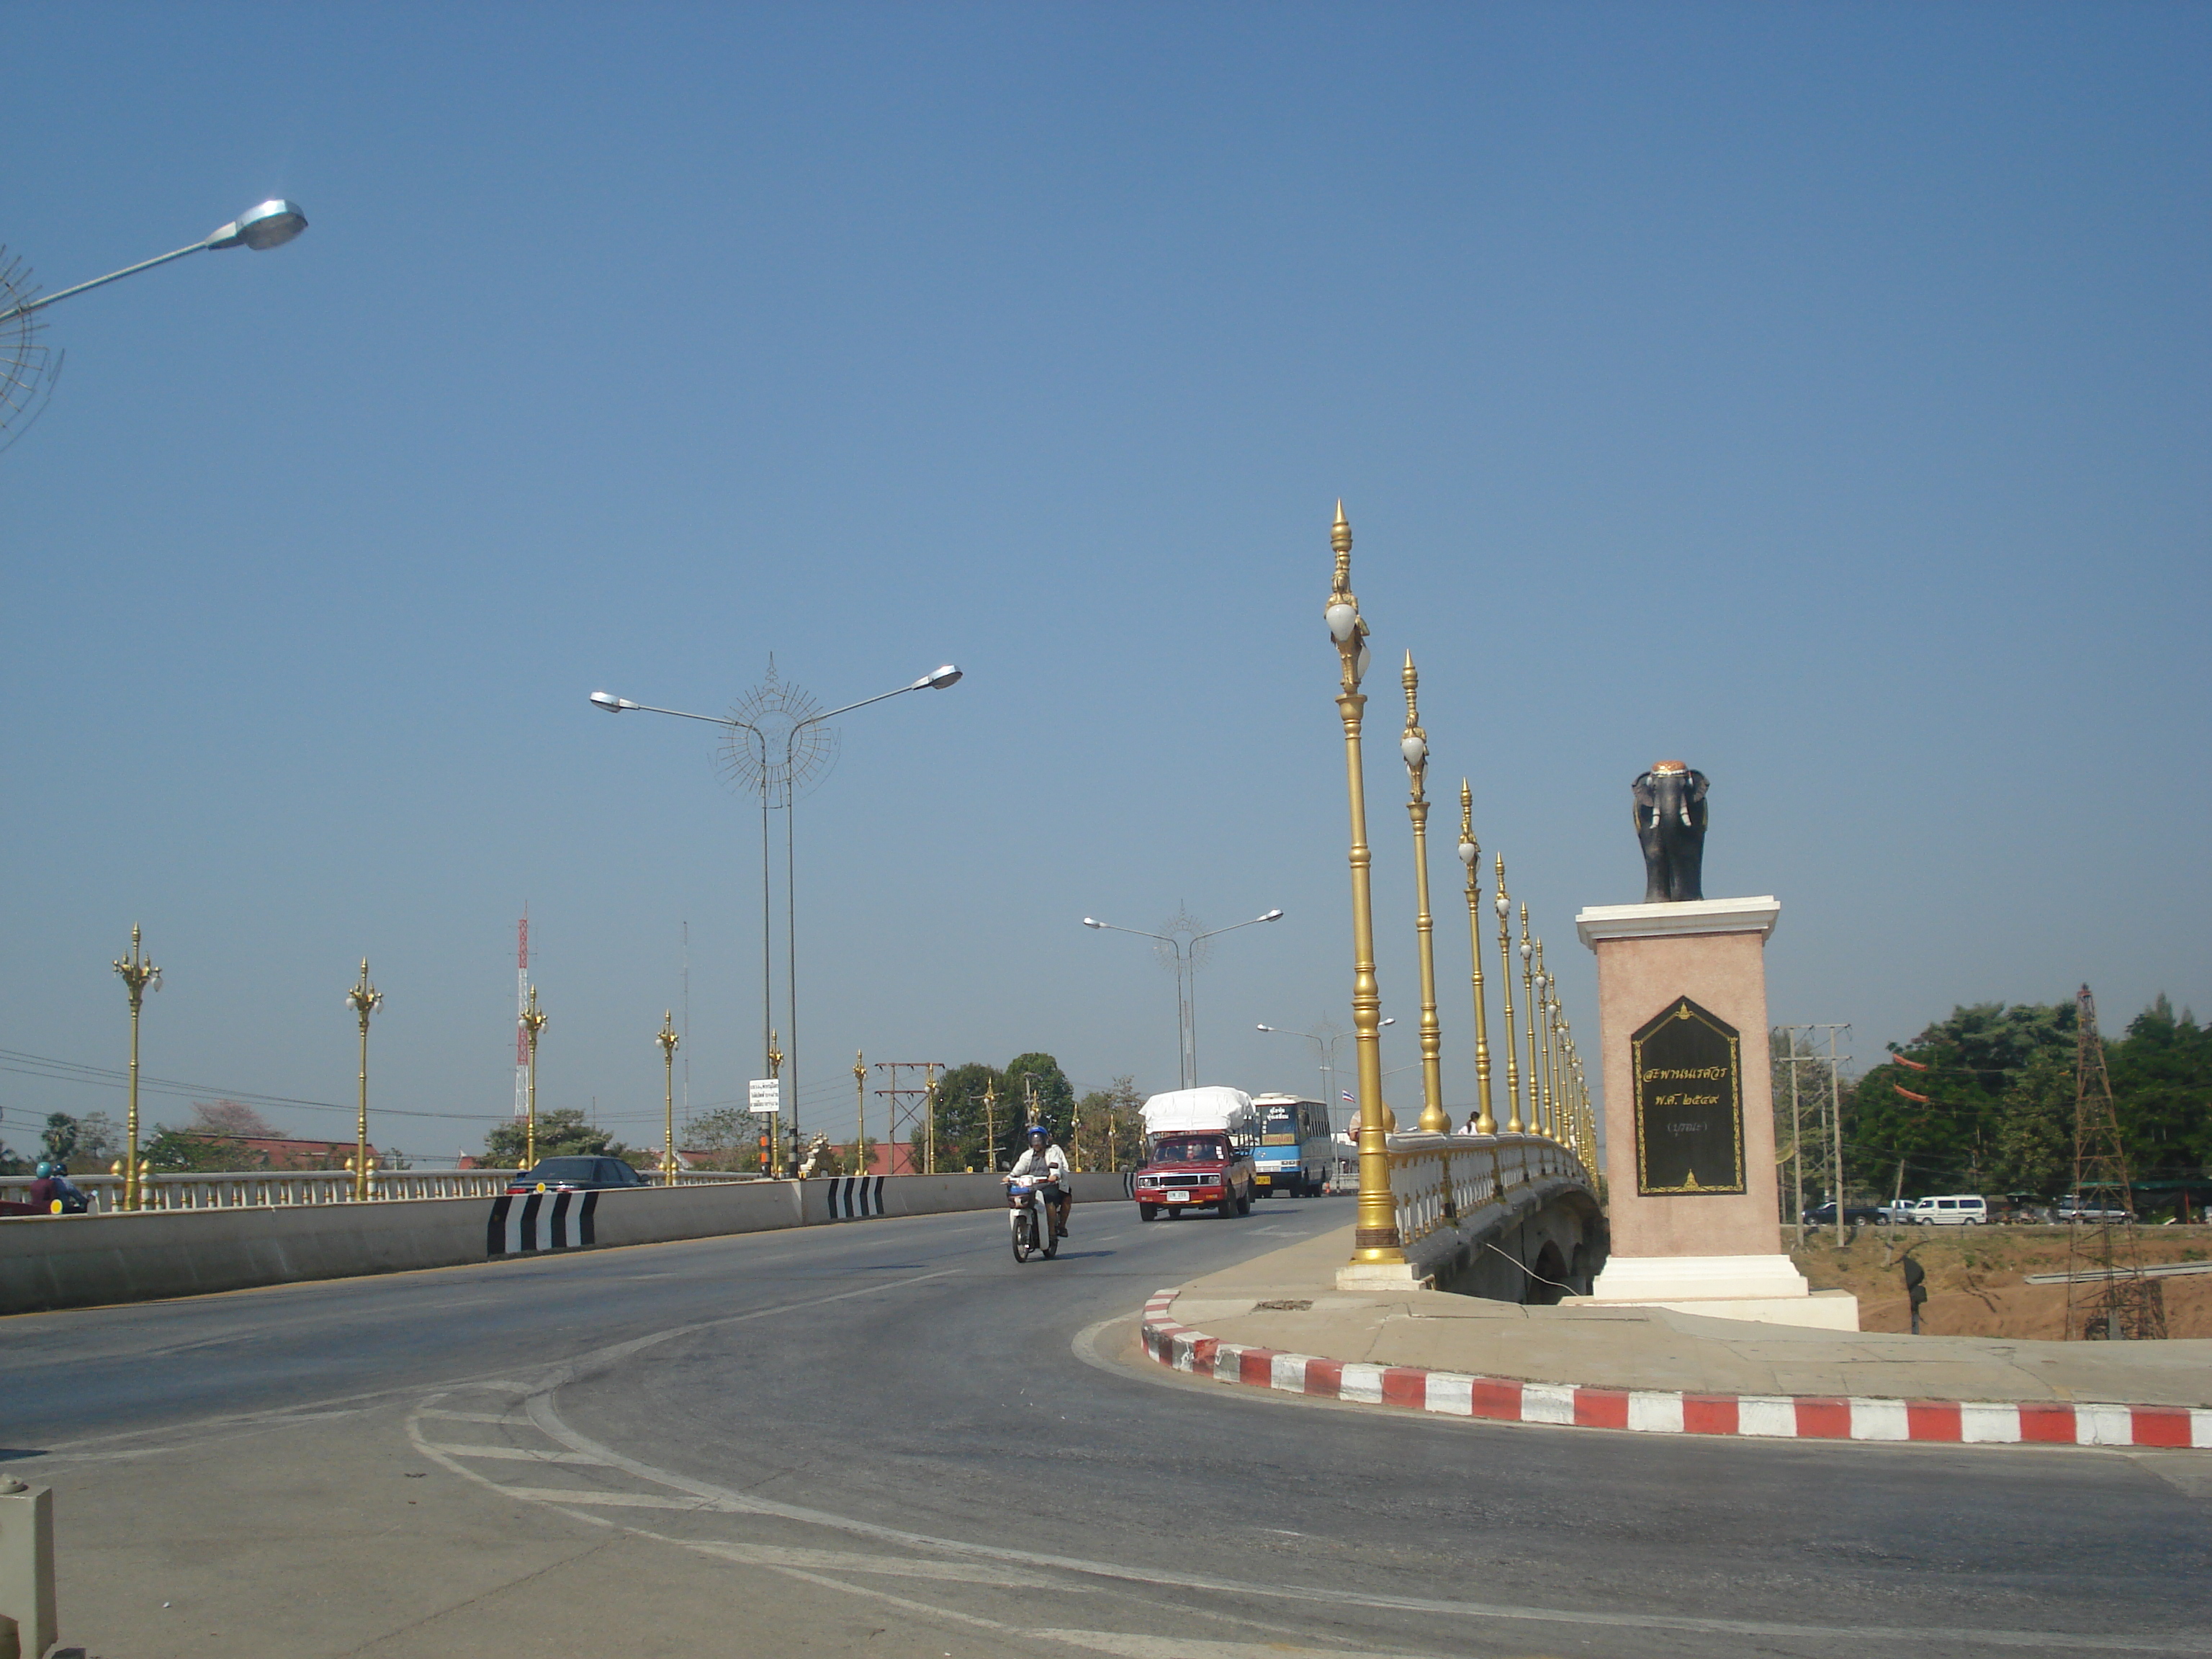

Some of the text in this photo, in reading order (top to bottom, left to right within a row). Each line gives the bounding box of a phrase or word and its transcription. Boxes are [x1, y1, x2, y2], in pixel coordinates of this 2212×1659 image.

[1643, 1066, 1728, 1082] สะพานนเรศวร
